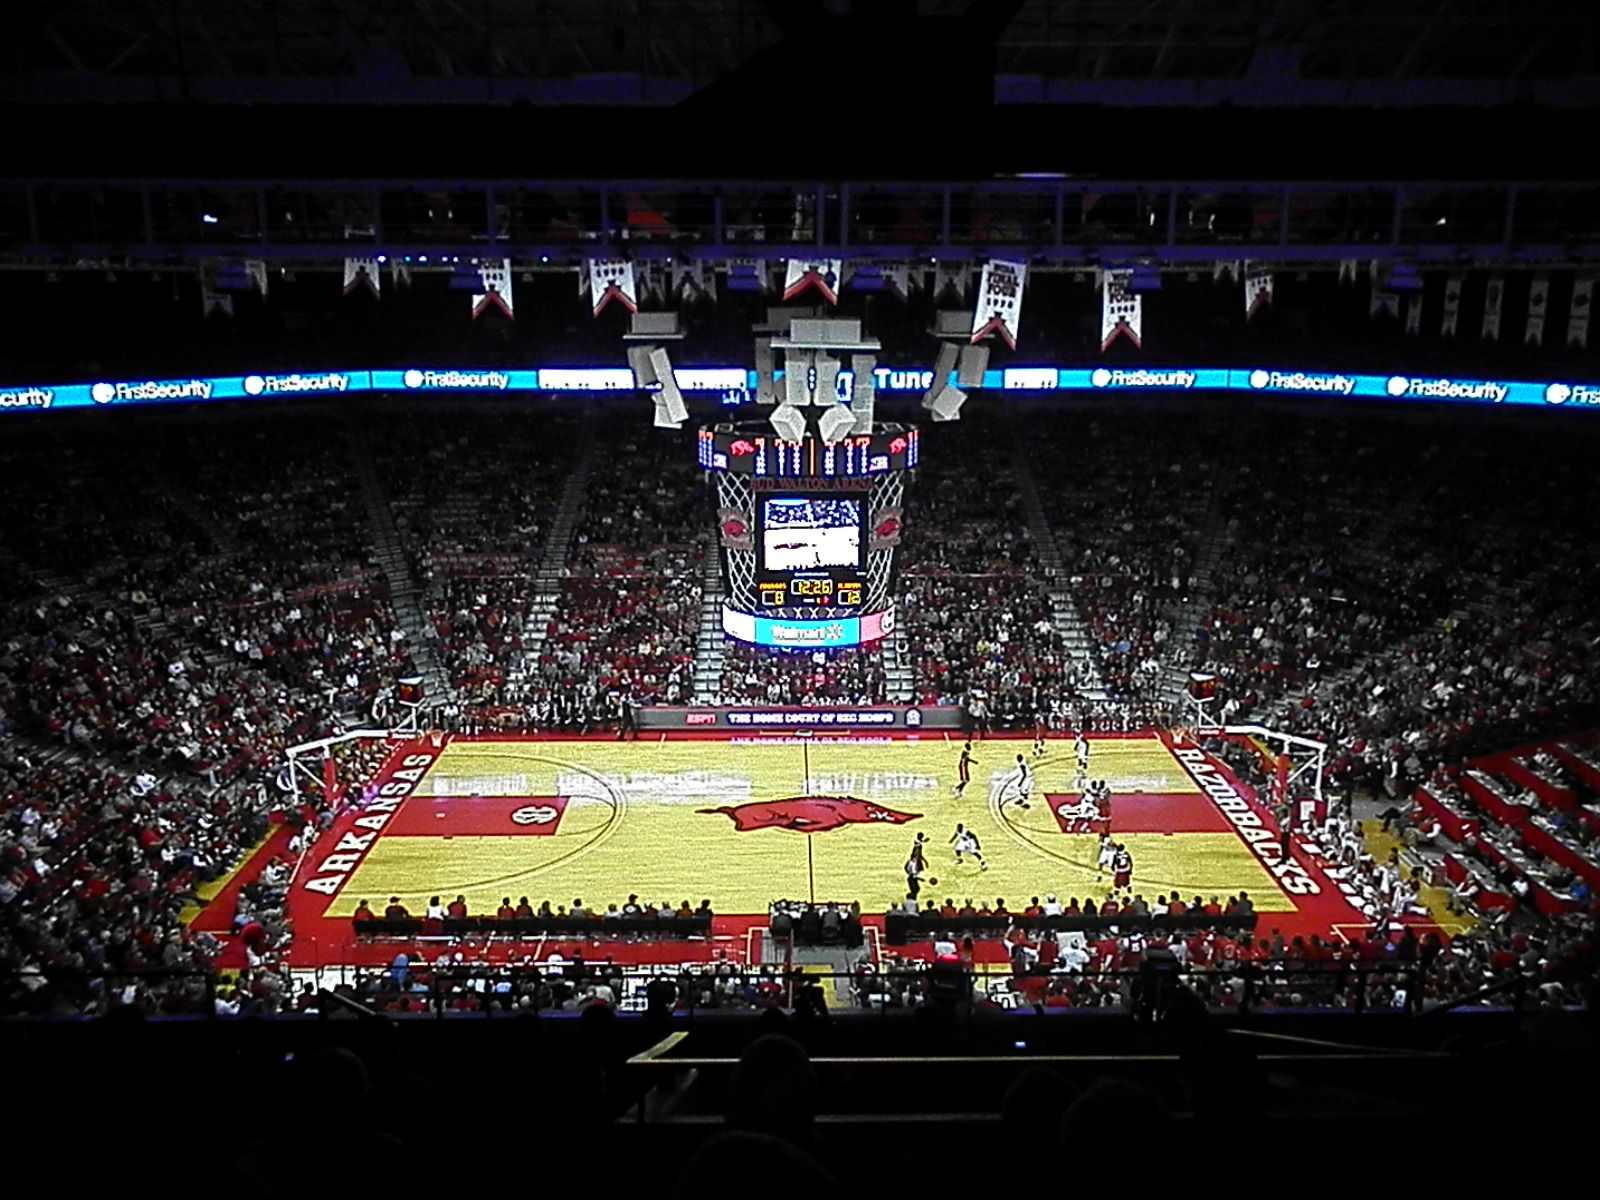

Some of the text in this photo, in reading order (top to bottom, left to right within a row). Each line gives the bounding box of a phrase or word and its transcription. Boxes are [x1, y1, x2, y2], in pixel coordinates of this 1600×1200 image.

[687, 713, 716, 724] ESPN
[304, 754, 433, 895] ARKANSAS
[1173, 748, 1321, 894] RAZORBACKS
